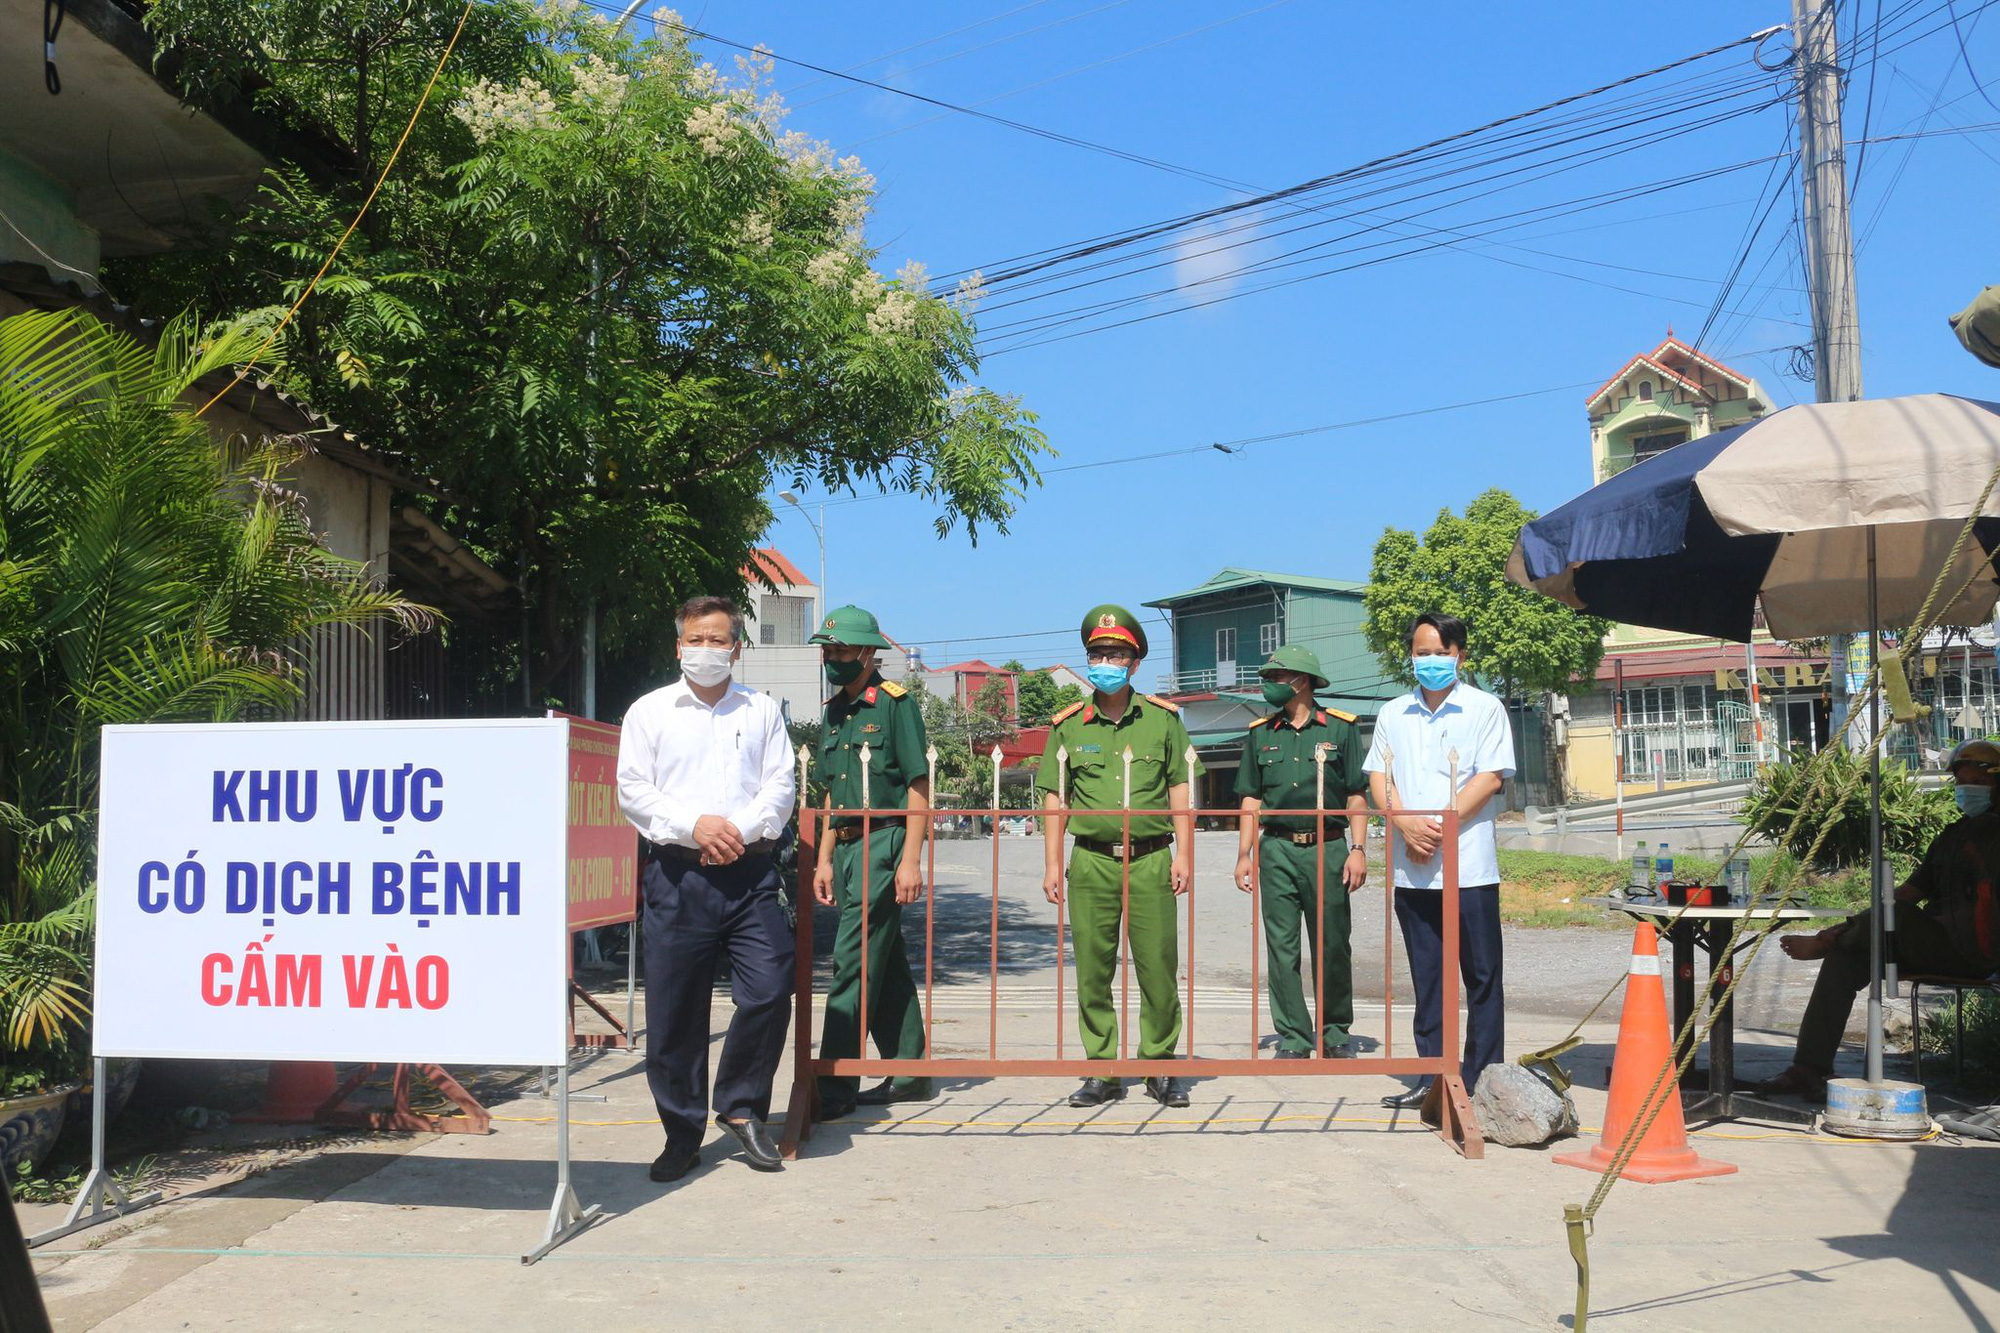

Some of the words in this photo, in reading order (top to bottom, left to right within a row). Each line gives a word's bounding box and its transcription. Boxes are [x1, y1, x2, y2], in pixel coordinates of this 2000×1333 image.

[212, 769, 318, 823] KHU
[338, 763, 443, 836] VỰC
[138, 849, 205, 914] CÓ
[226, 861, 350, 928] DỊCH
[372, 850, 520, 928] BỆNH
[585, 856, 613, 901] COVID
[621, 856, 632, 896] 19
[201, 933, 323, 1008] CẤM
[341, 942, 450, 1010] VÀO
